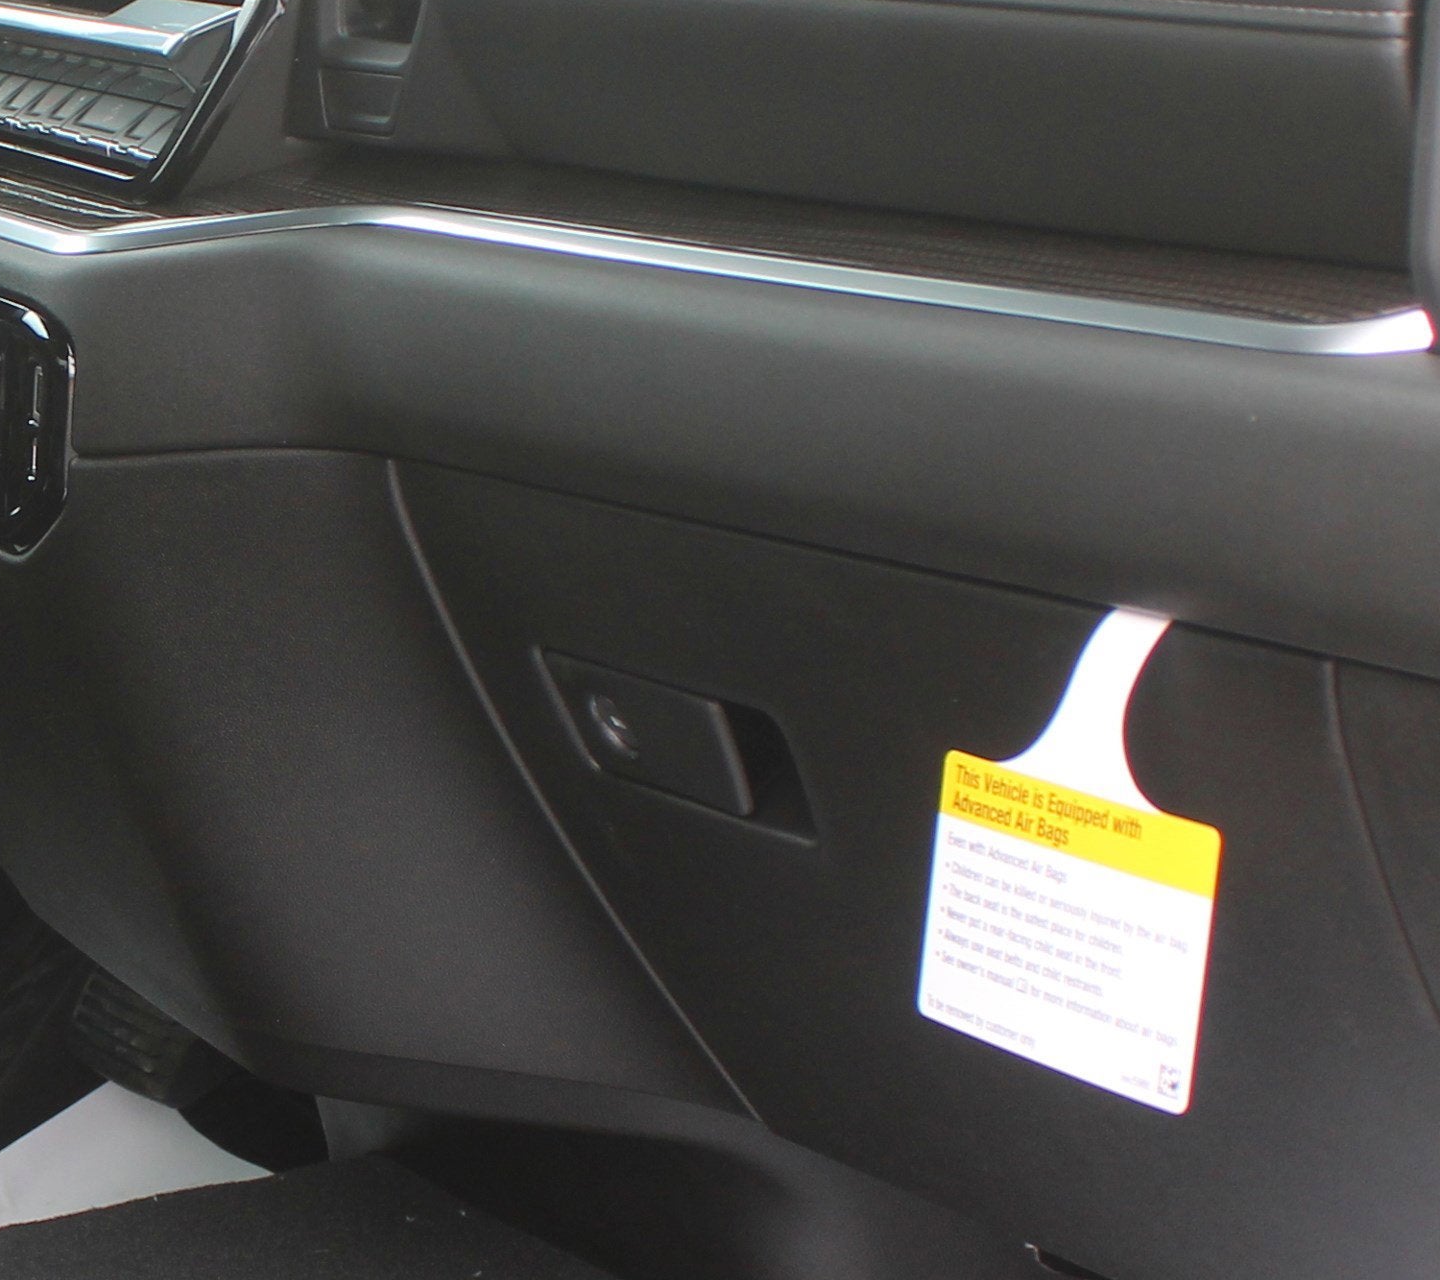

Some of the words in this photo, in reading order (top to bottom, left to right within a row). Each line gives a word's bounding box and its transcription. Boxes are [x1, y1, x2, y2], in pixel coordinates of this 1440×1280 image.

[952, 790, 1011, 826] Advanced
[1014, 811, 1033, 834] Air
[1035, 818, 1069, 850] Bags
[955, 763, 980, 789] This
[982, 773, 1029, 804] Vehicle
[1032, 789, 1044, 809] is
[1046, 792, 1108, 832] Equipped
[1112, 812, 1143, 840] with
[947, 831, 966, 849] Even
[968, 838, 985, 855] with
[987, 846, 1029, 870] Advanced
[1031, 860, 1042, 875] Air
[951, 861, 983, 883] Children
[984, 875, 998, 888] can
[1001, 879, 1011, 892] be
[1013, 882, 1036, 901] killed
[1039, 893, 1047, 905] or
[1049, 895, 1086, 920] seriously
[1123, 920, 1132, 936] by
[1136, 924, 1151, 939] the
